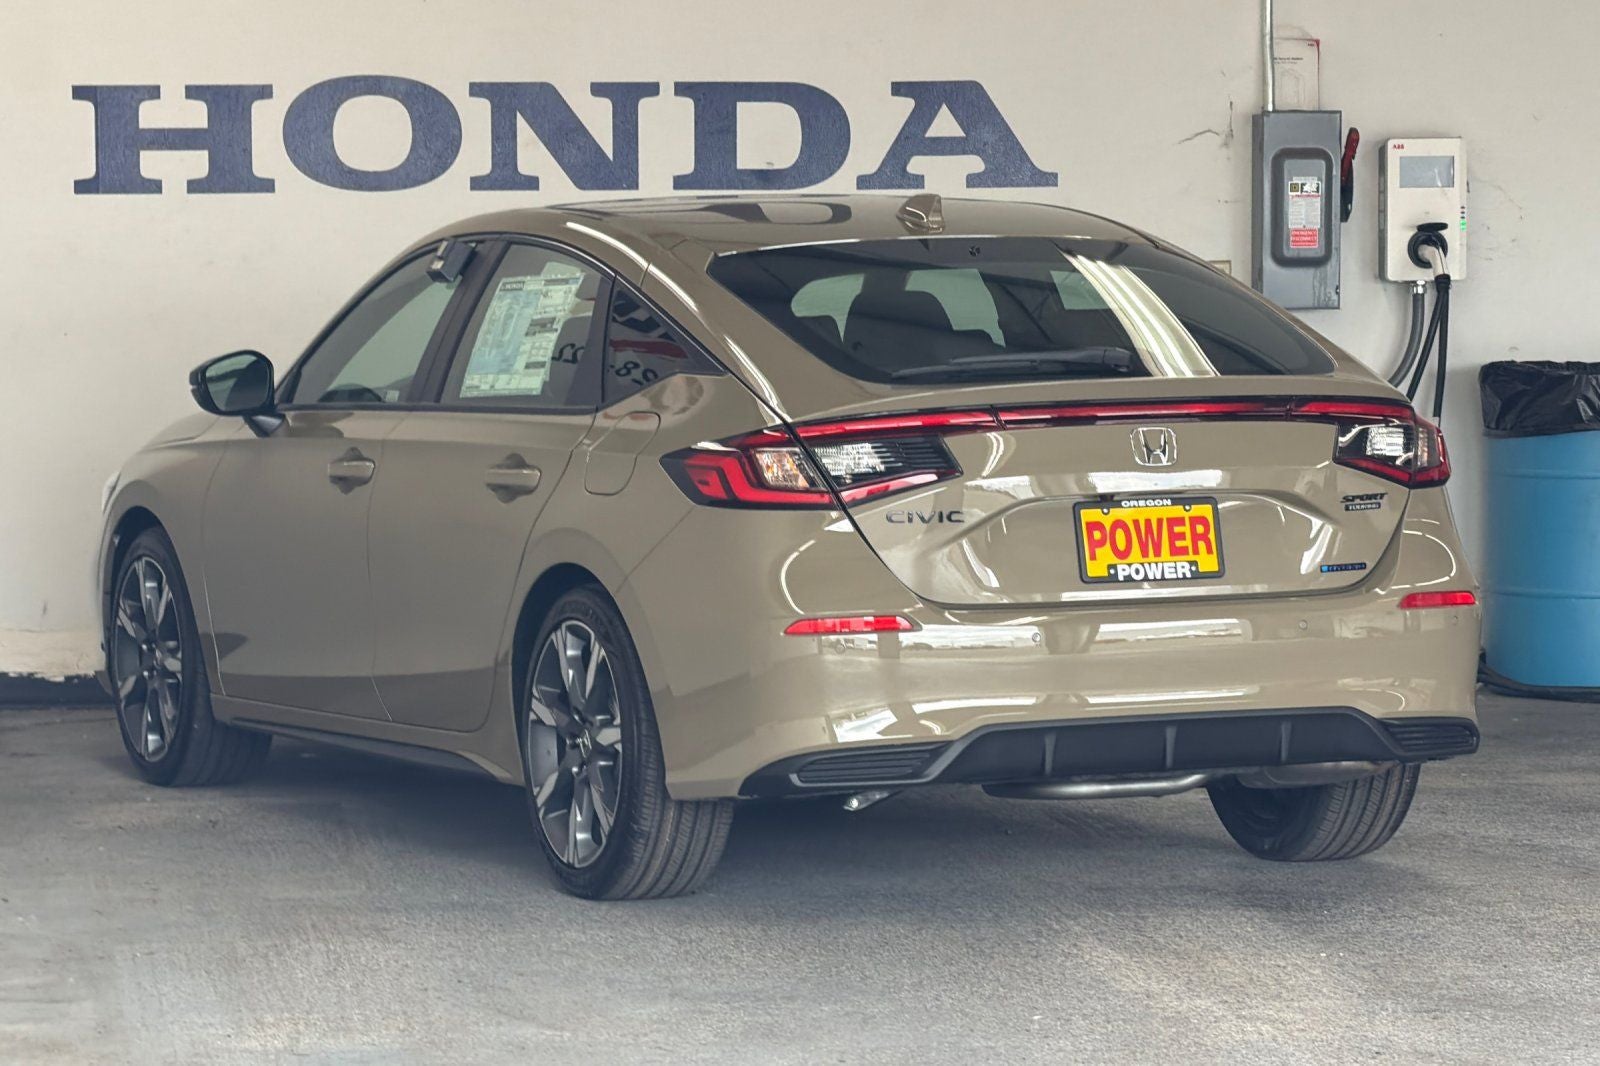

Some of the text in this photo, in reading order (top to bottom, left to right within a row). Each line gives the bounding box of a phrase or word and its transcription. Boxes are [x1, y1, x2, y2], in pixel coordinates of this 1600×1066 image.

[71, 74, 1058, 194] HONDA
[1121, 498, 1172, 508] OREGON
[1340, 492, 1388, 504] SPORT
[886, 510, 965, 524] CIVIC
[1085, 515, 1214, 561] POWER
[1117, 562, 1192, 581] POWER
